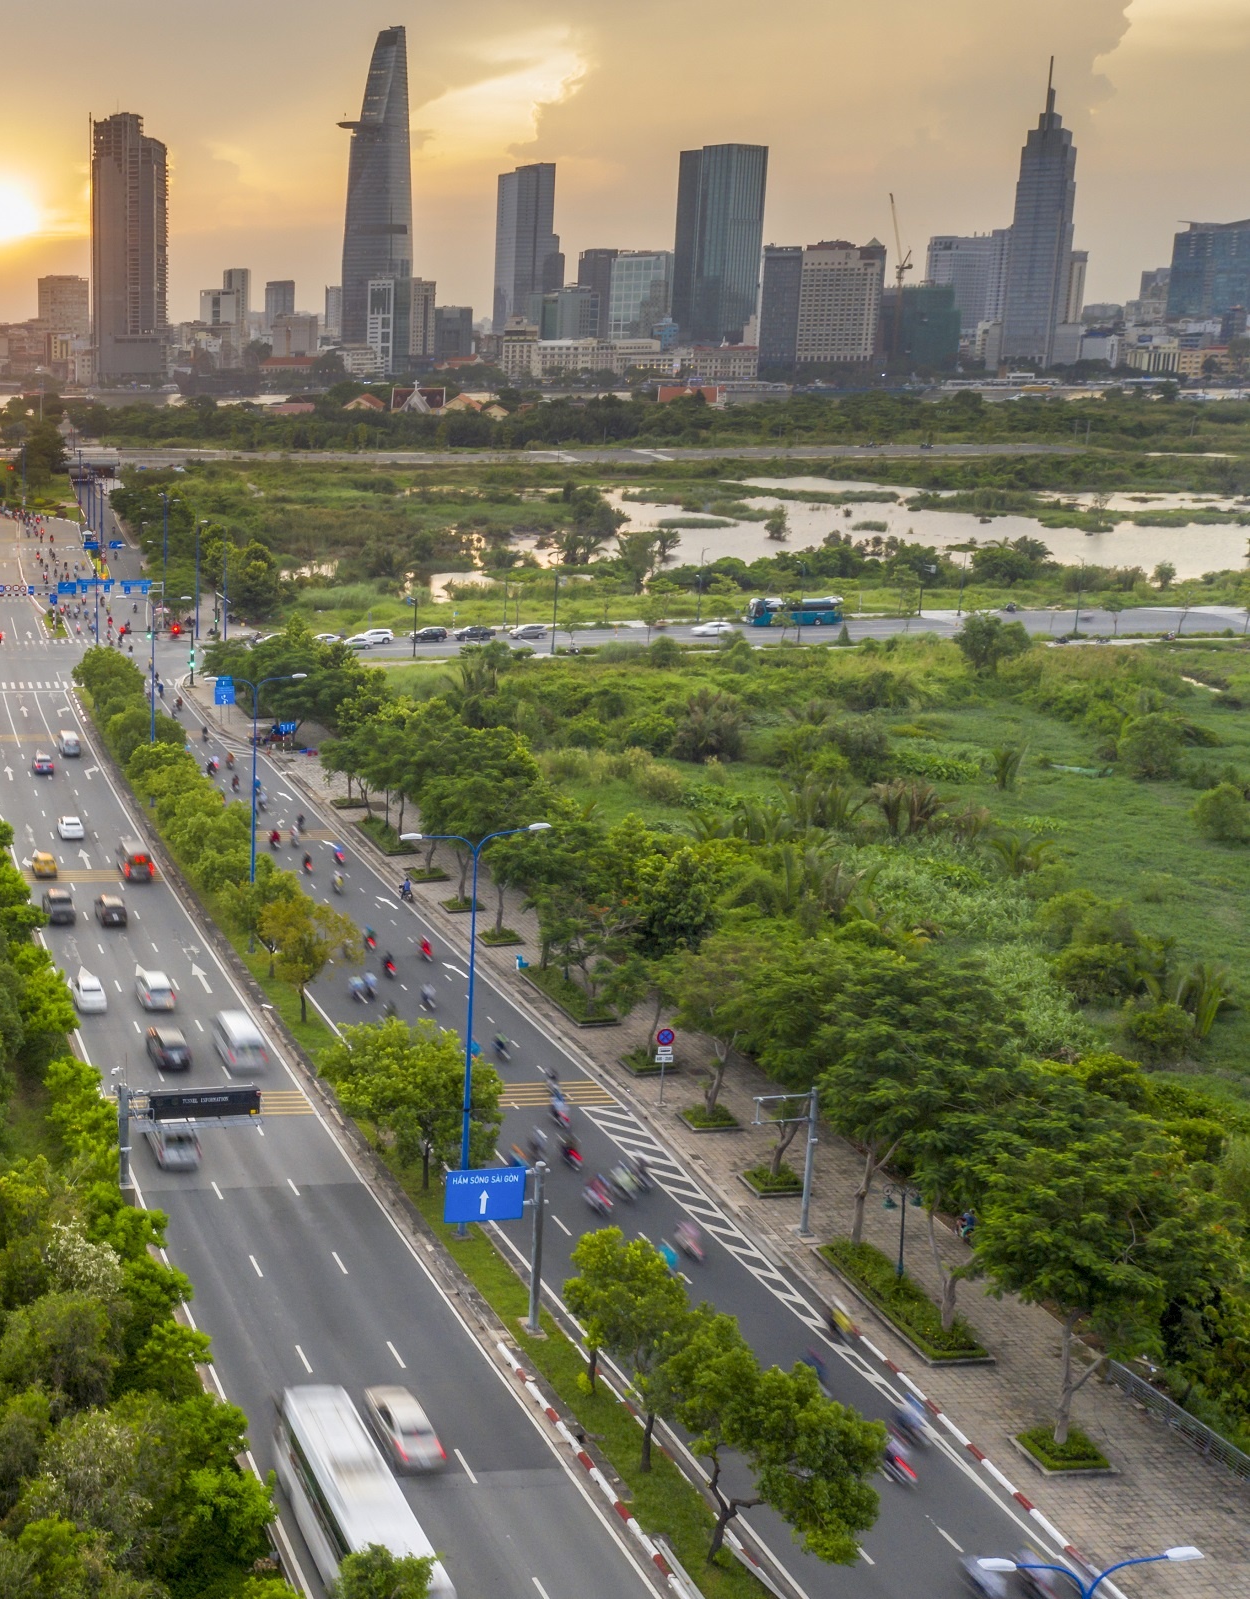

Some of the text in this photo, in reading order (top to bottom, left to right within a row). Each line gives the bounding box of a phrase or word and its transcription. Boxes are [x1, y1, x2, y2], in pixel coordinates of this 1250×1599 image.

[470, 1174, 489, 1184] SÔNG
[491, 1173, 503, 1183] SÀI
[504, 1173, 519, 1183] GÒN
